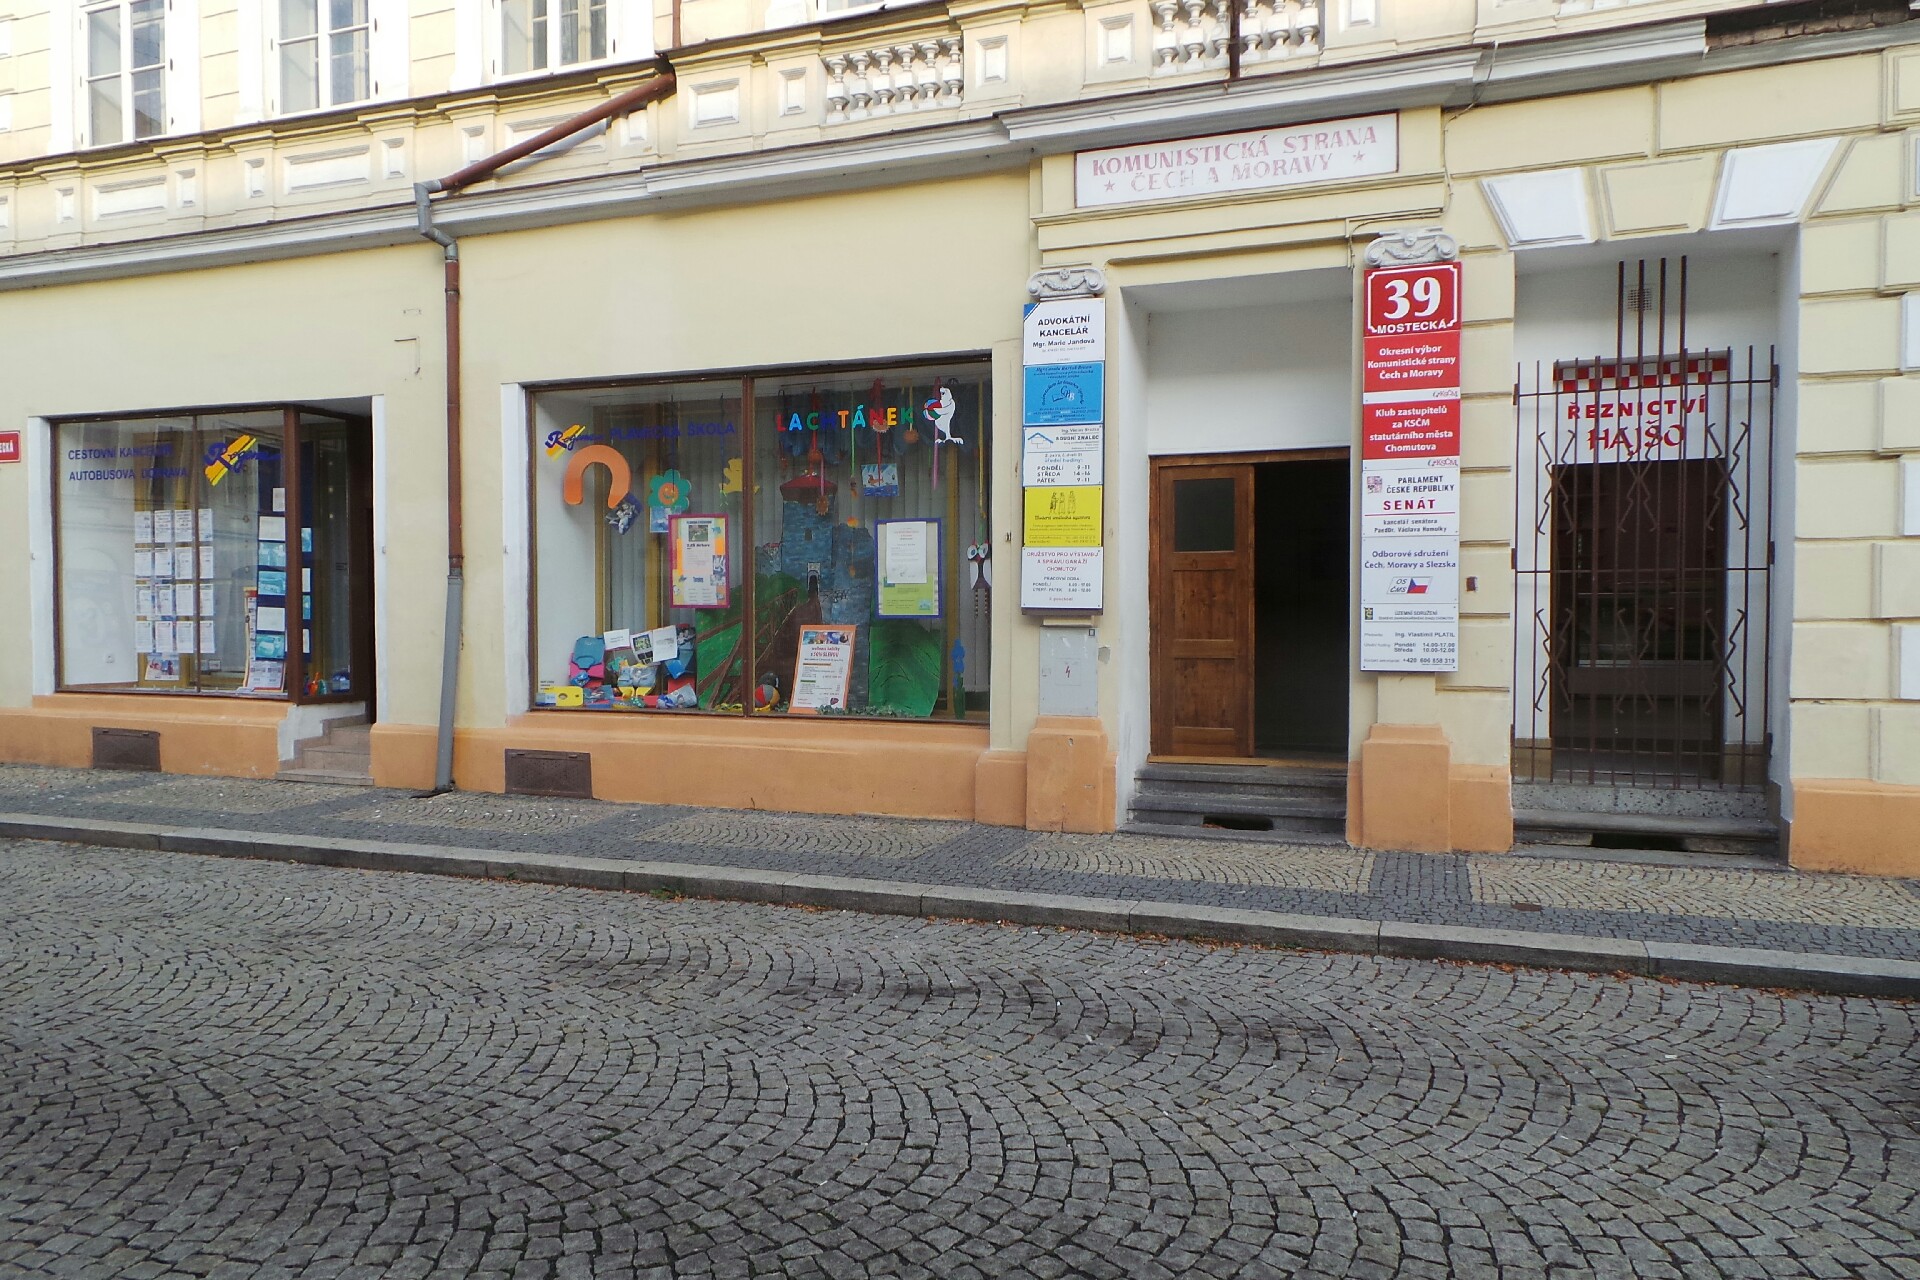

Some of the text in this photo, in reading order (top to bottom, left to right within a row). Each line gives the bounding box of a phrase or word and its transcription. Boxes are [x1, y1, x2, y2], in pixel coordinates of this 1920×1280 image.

[1093, 126, 1377, 177] KOMUNISTICKÁ STRANA
[1131, 153, 1333, 192] ČECH A MORAVY
[1383, 277, 1441, 319] 39
[1038, 315, 1090, 326] ADVOKÁTNÍ
[1377, 319, 1447, 334] MOSTECKÁ
[1040, 326, 1088, 337] KANCELÁŘ
[1379, 344, 1442, 356] Okresní výbor
[1367, 356, 1456, 369] Komunistické strany
[1379, 370, 1400, 379] Čech
[1409, 369, 1443, 378] Moravy
[1375, 405, 1447, 417] Klub zastupitelů
[1567, 393, 1707, 420] ŘEZNICTVÍ
[775, 404, 914, 432] LACHTÁNEK
[1404, 418, 1430, 427] KSČM
[687, 420, 735, 436] ŠKOLA
[1369, 429, 1453, 441] statutárního města
[1587, 419, 1685, 457] HAJŠO
[1384, 443, 1437, 452] Chomutova
[1398, 476, 1443, 484] PARLAMENT
[1386, 484, 1455, 494] ČESKÉ REPUBLIKY
[1383, 496, 1436, 511] SENÁT
[1372, 549, 1449, 558] Odborové sdružení
[1387, 561, 1418, 570] Moravy
[1426, 560, 1456, 568] Slezska
